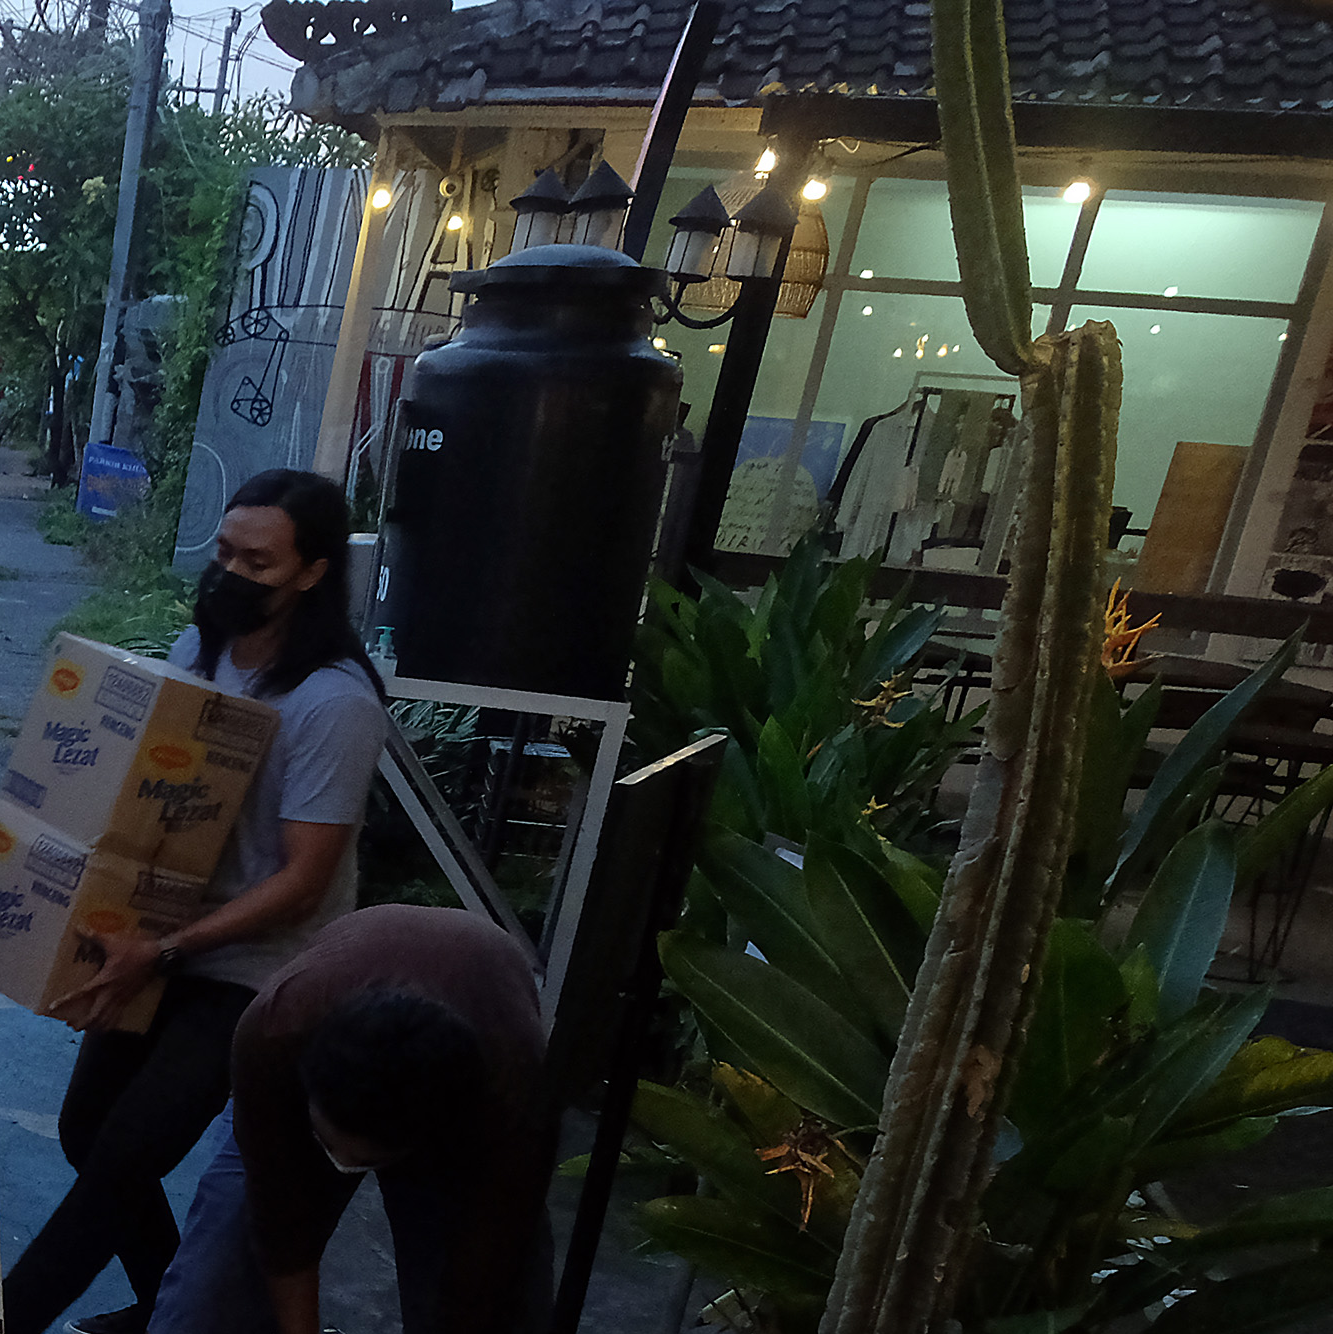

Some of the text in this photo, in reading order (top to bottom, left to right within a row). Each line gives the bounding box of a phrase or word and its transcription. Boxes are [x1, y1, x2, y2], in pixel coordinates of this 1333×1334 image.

[43, 721, 91, 746] Magic
[53, 743, 100, 766] Lezat
[138, 777, 210, 801] Magic
[159, 799, 222, 823] Lezat
